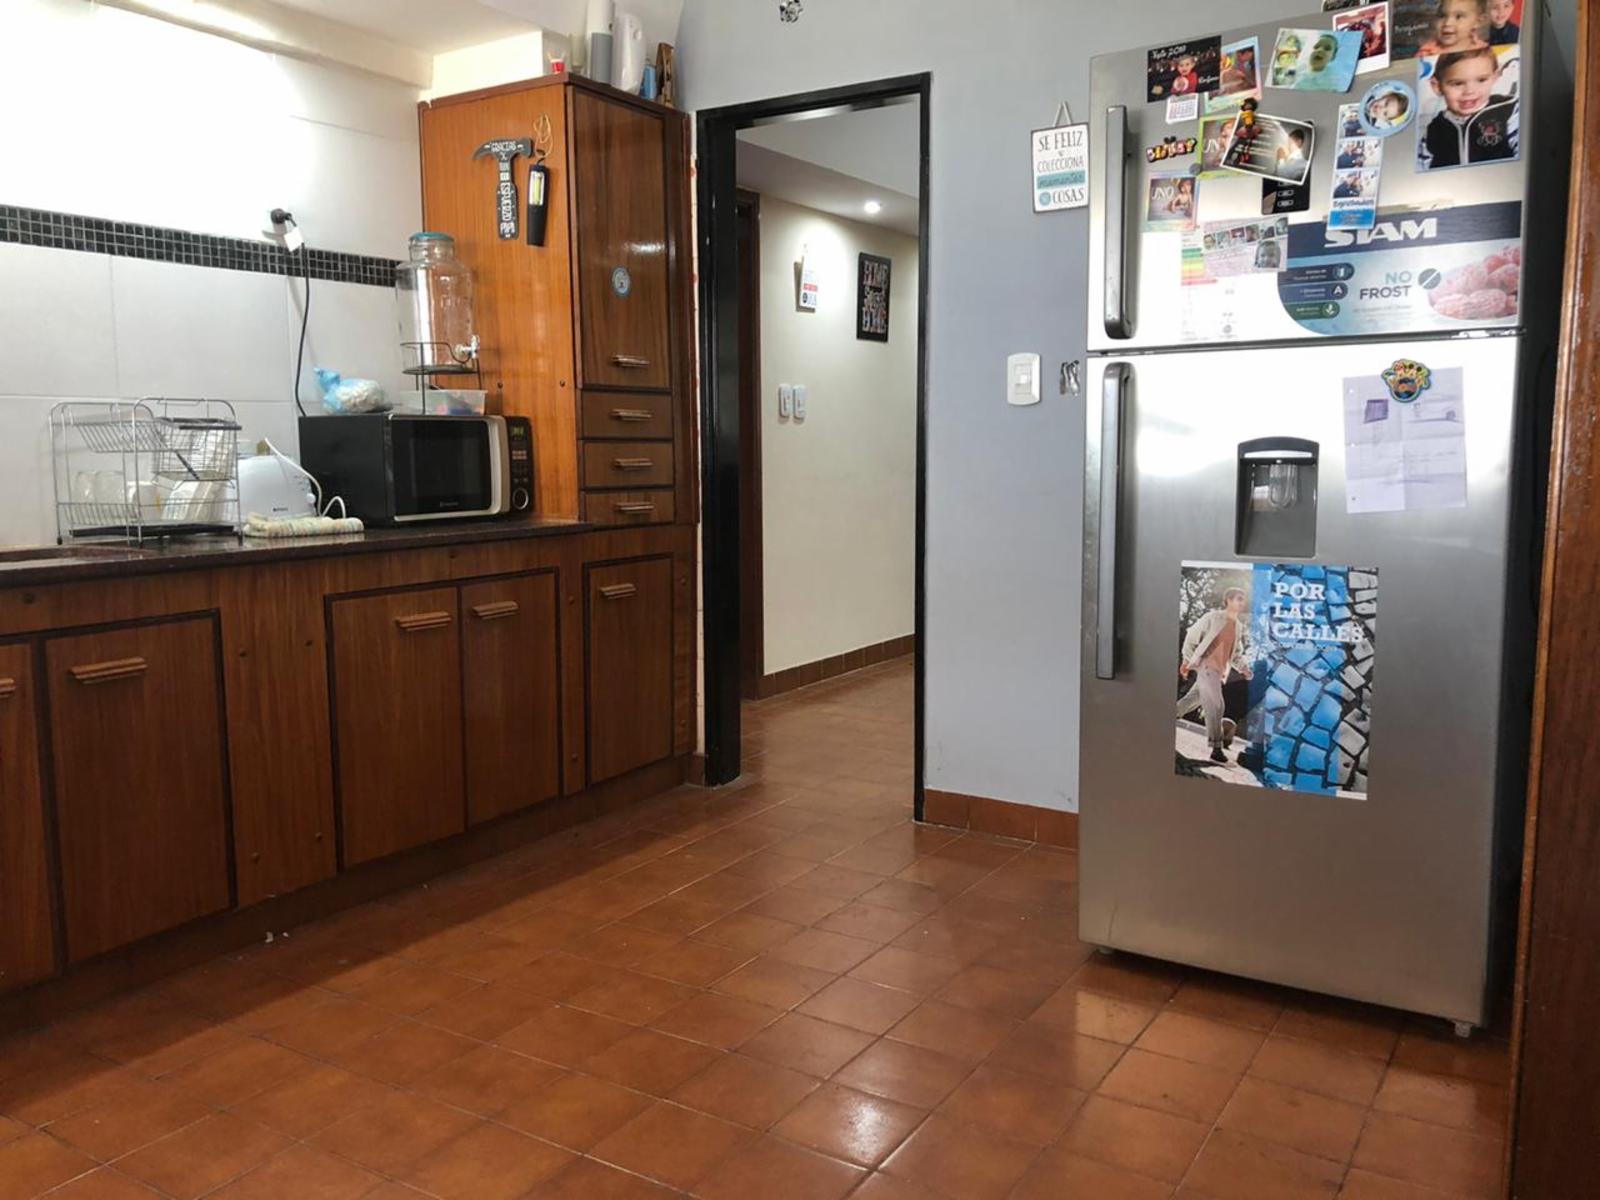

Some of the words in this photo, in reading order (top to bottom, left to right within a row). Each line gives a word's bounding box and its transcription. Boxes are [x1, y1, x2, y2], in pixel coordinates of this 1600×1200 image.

[1038, 135, 1051, 152] SE
[1054, 130, 1083, 150] FELIZ
[1037, 157, 1084, 173] COLECCIONA
[1052, 188, 1084, 203] COSAS
[1324, 218, 1438, 248] SIAM
[1385, 271, 1412, 284] NO
[1359, 285, 1412, 300] FROST
[1273, 582, 1326, 601] POR
[1272, 602, 1315, 620] LAS
[1272, 621, 1364, 643] CALLES
